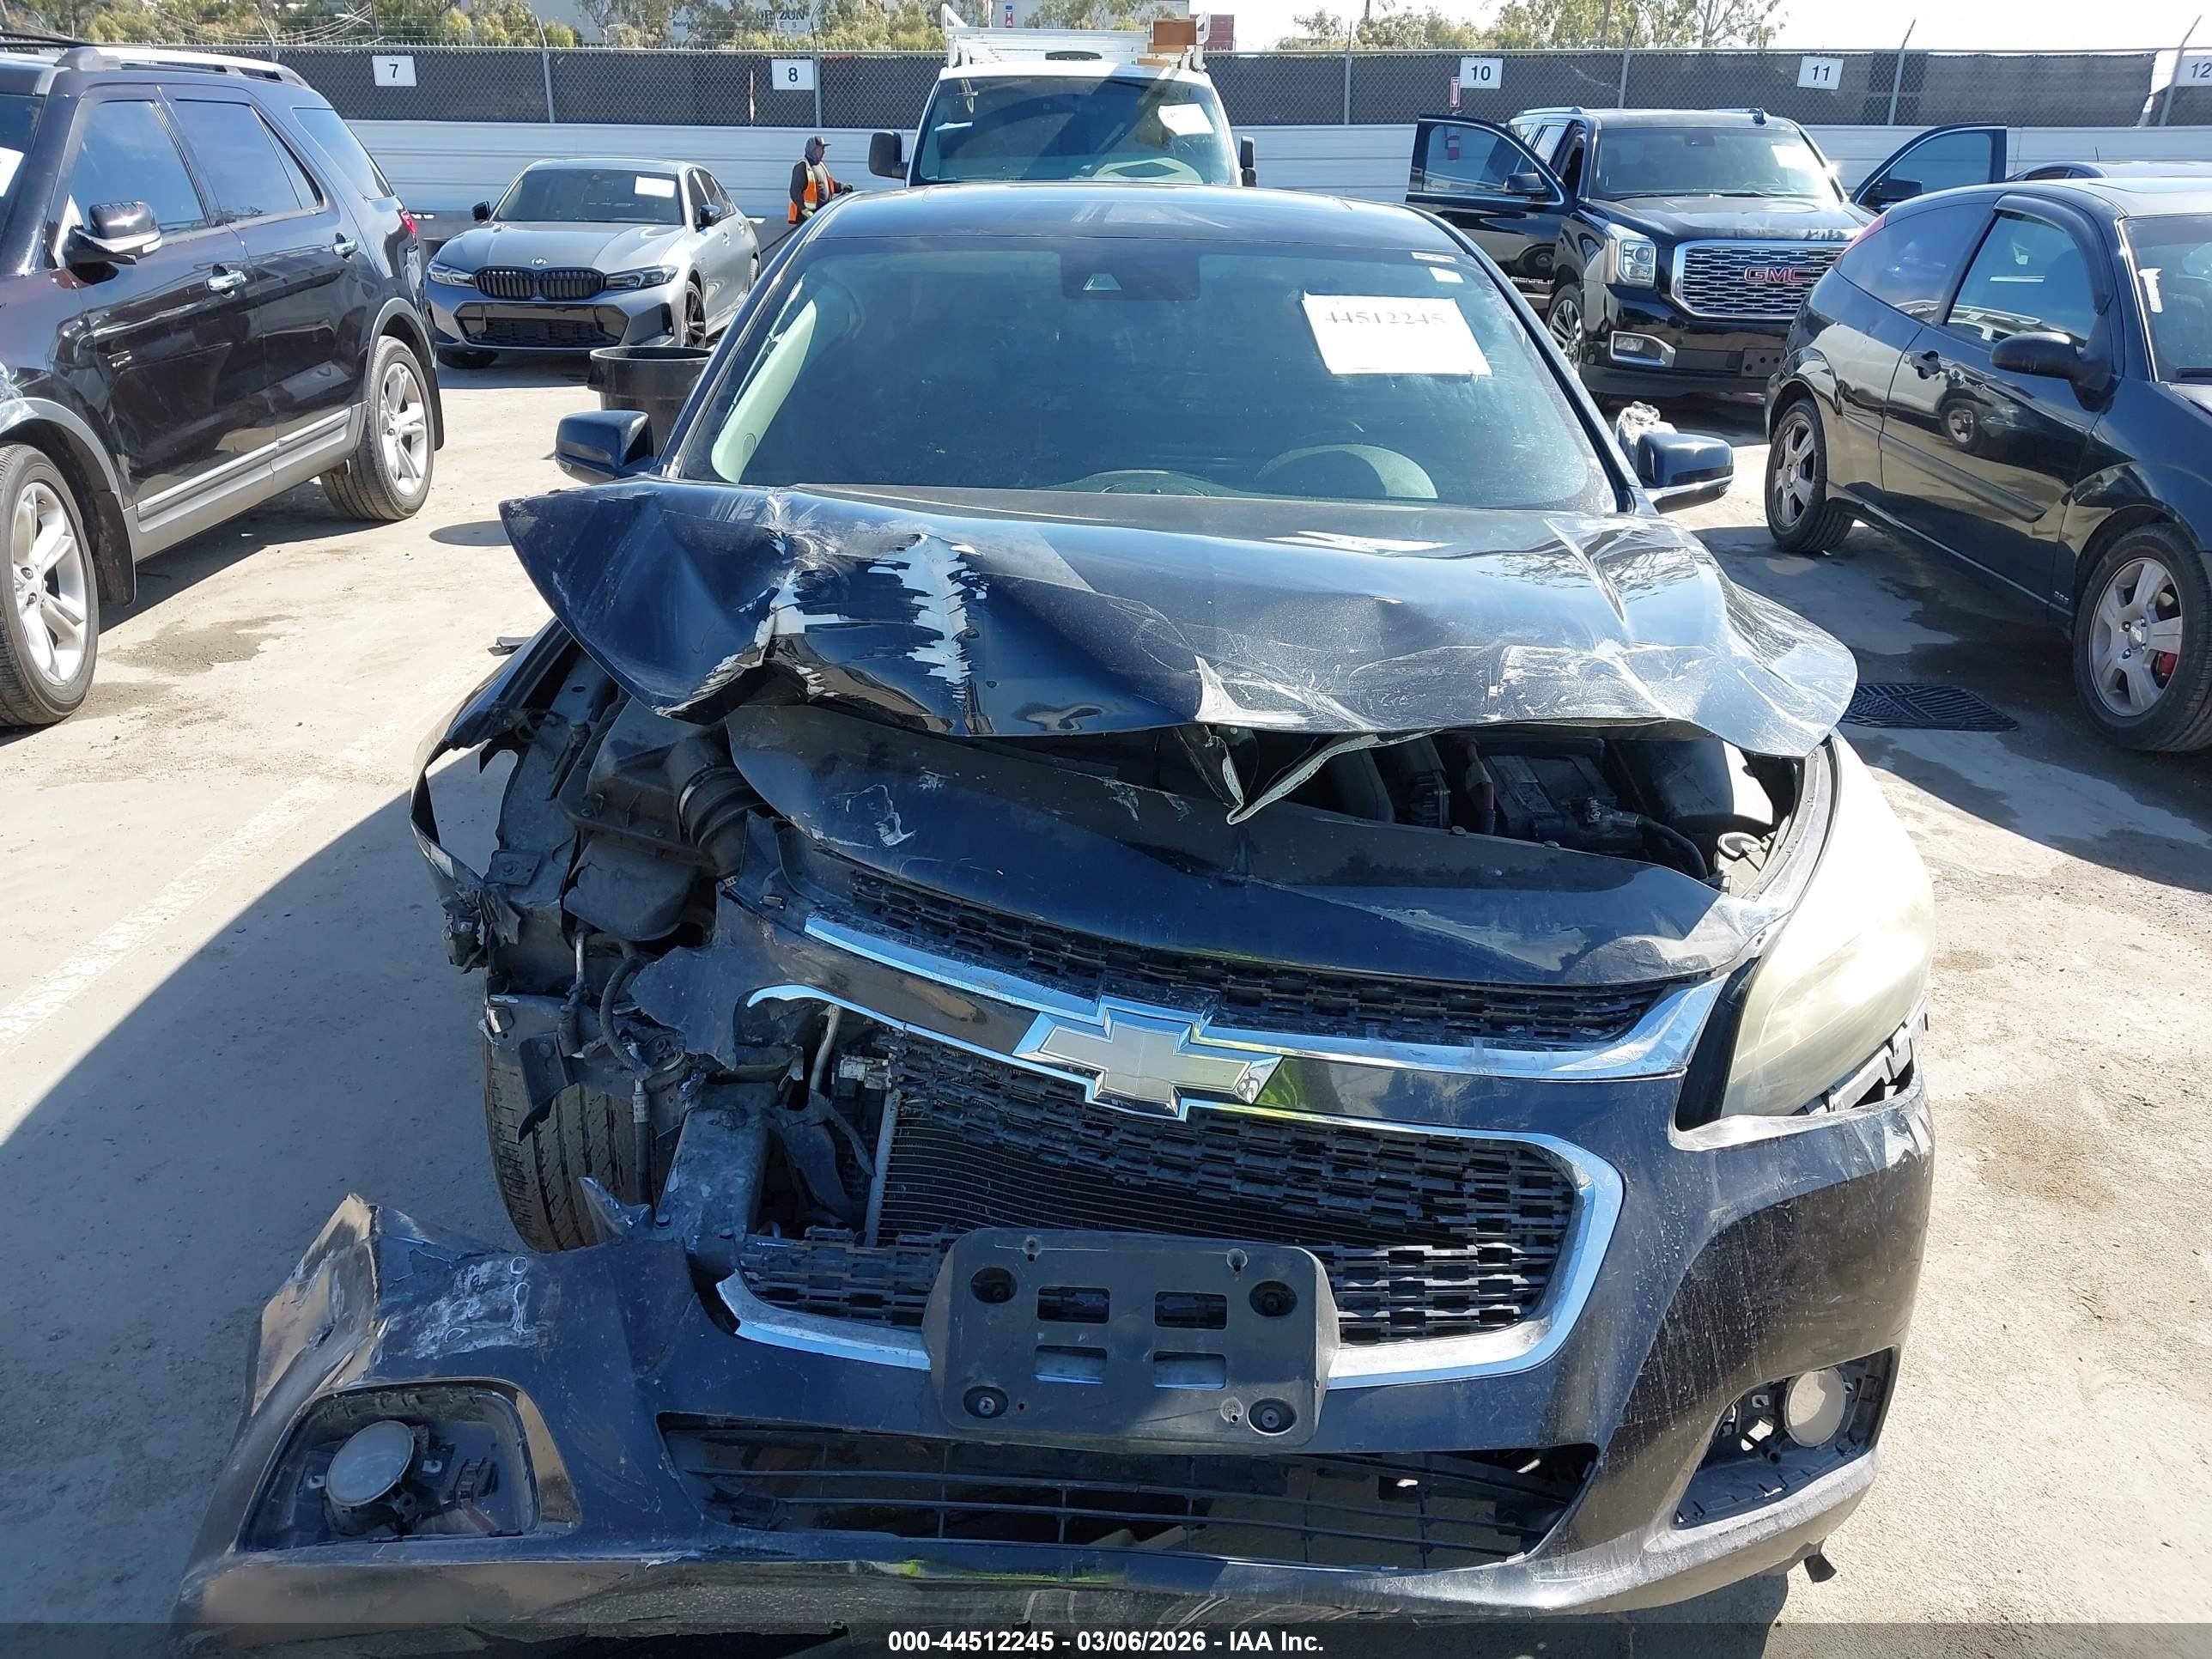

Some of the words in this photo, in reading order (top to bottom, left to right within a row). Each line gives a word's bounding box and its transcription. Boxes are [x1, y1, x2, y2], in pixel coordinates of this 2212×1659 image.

[388, 64, 398, 78] 7
[787, 67, 798, 82] 8
[1470, 64, 1492, 82] 10
[1811, 64, 1831, 82] 11
[2191, 62, 2212, 78] 12
[1745, 267, 1810, 283] GMC
[1325, 311, 1445, 325] 44512245
